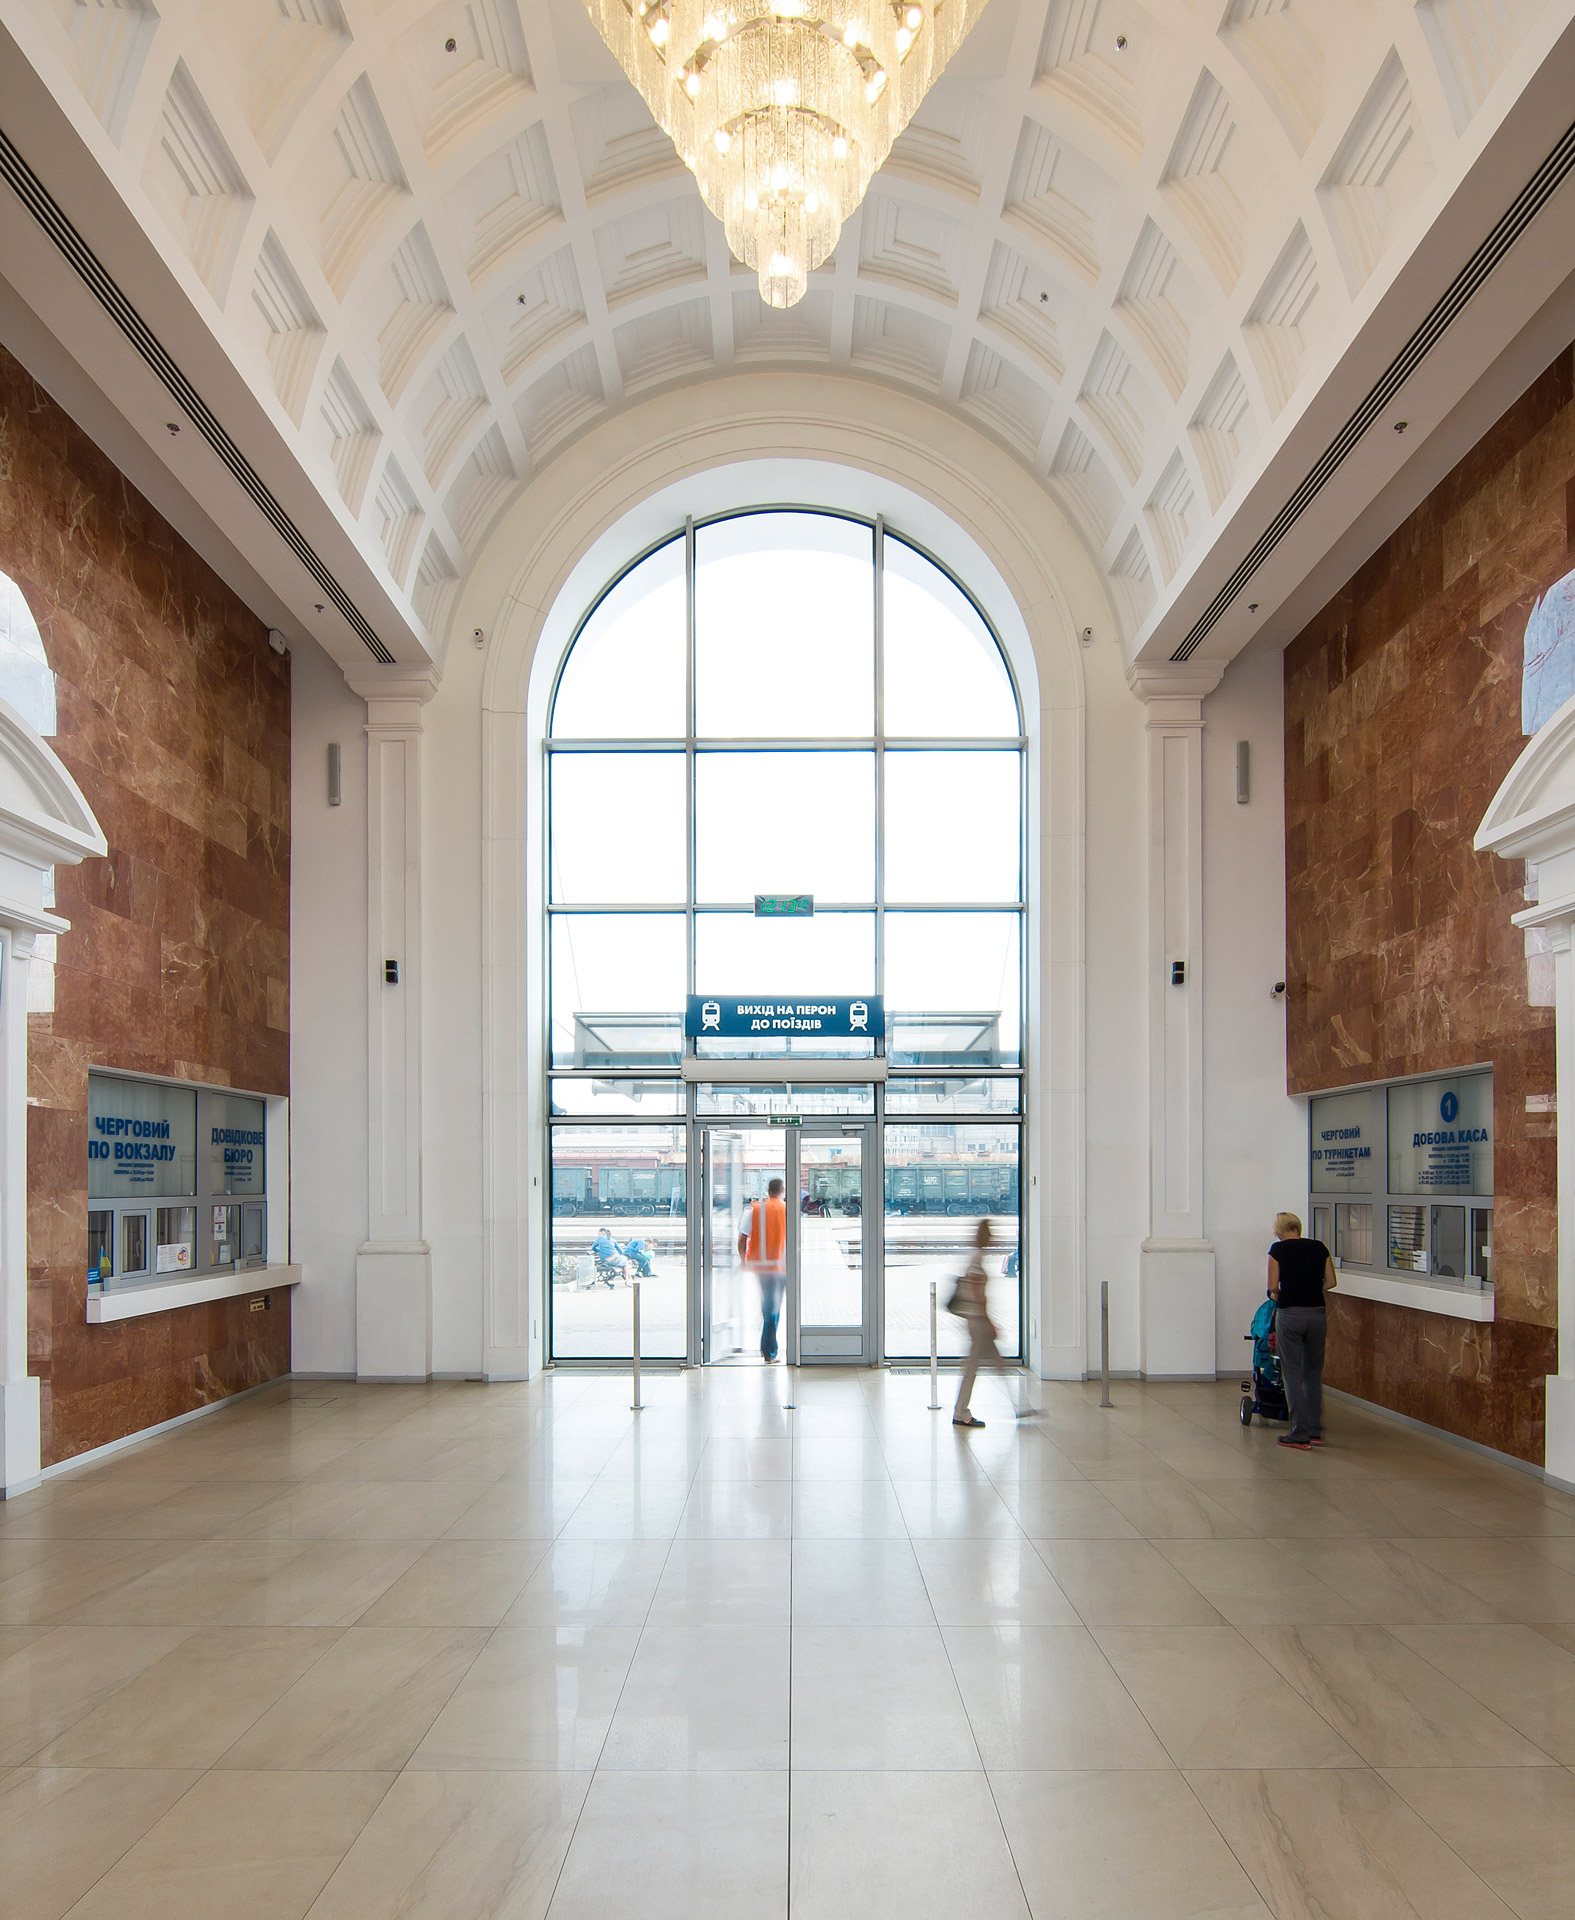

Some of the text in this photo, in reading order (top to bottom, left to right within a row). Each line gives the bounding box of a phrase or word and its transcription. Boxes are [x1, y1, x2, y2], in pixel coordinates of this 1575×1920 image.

[737, 1005, 837, 1016] ВИХІД НА ПЕРОН
[751, 1017, 822, 1030] ДО ПОЇЗДІВ
[95, 1116, 170, 1139] ЧЕРГОВИЙ
[1321, 1125, 1360, 1141] ЧЕРГОВИЙ
[211, 1128, 263, 1146] ДОВІДКОВЕ
[1412, 1128, 1488, 1148] ДОБОВА КАСА
[88, 1140, 176, 1162] ПО ВОКЗАЛУ
[224, 1148, 253, 1163] БЮРО
[1312, 1146, 1370, 1160] ПО ТУРНІКЕТАМ
